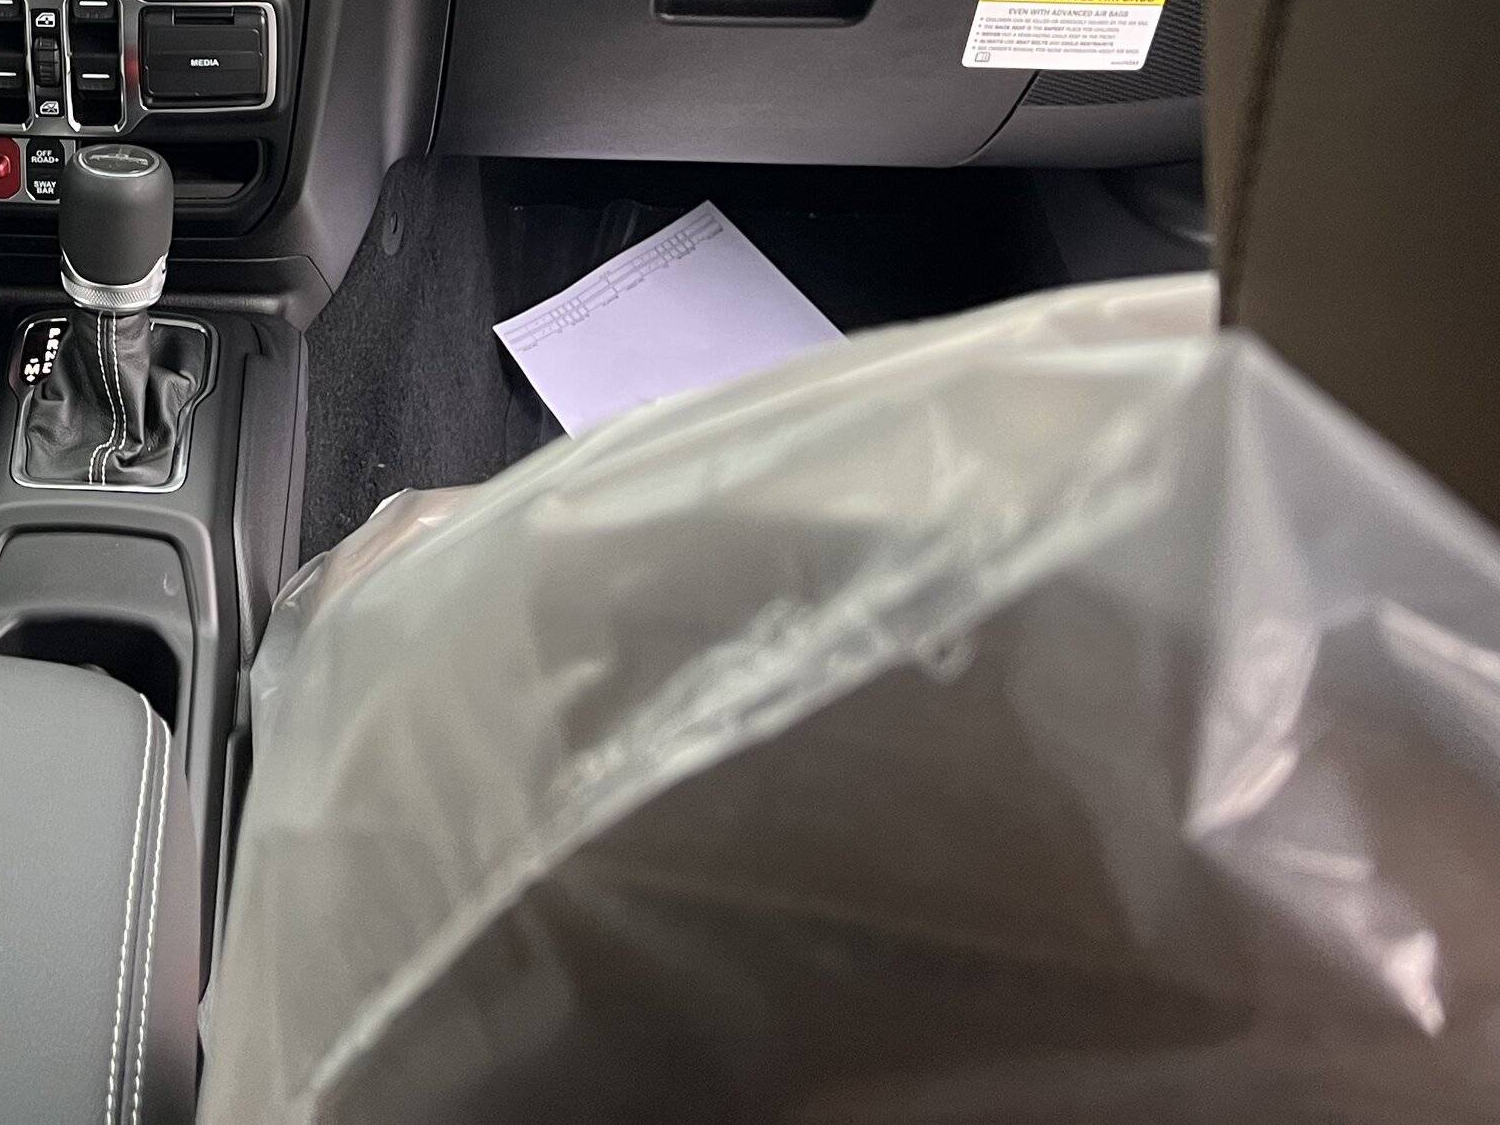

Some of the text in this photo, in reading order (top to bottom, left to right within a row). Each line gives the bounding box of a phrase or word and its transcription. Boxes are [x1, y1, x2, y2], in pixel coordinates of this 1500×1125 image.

[1051, 9, 1093, 17] ADVANCED
[190, 58, 220, 67] MEDIA
[33, 180, 56, 188] SWAY
[36, 187, 54, 195] BAR
[49, 327, 61, 338] P
[47, 338, 59, 350] R
[45, 350, 57, 362] N
[24, 363, 40, 376] M
